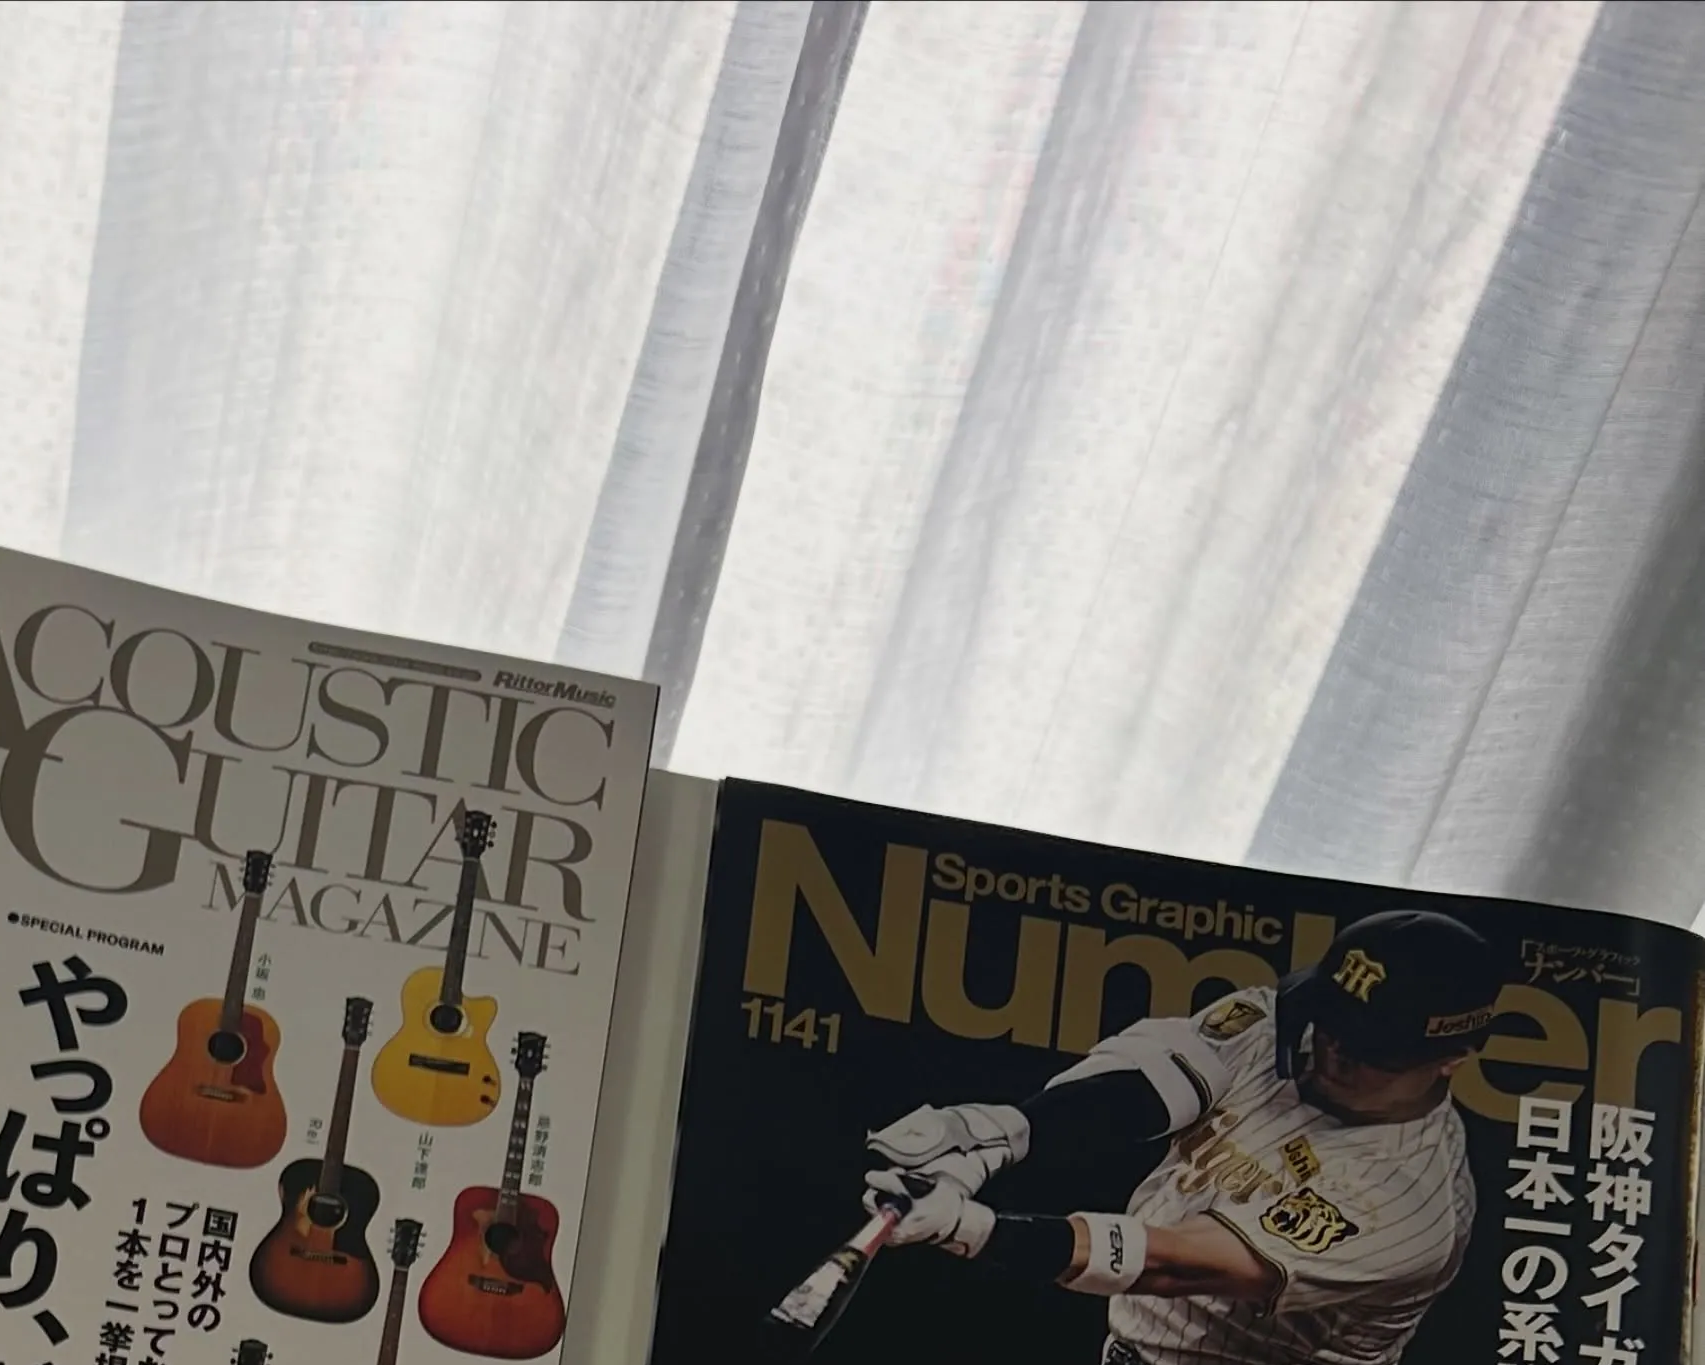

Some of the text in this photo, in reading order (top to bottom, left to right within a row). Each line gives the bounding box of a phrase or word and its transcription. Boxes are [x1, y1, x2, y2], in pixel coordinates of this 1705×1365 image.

[0, 704, 597, 923] GUITAR
[19, 913, 165, 956] SPECIAL PROGRAM
[202, 862, 583, 976] MAGAZNE
[931, 852, 1284, 948] Sports Graphic
[740, 818, 1683, 1125] Numer
[740, 994, 843, 1055] 1141
[187, 1207, 240, 1334] 国内外の
